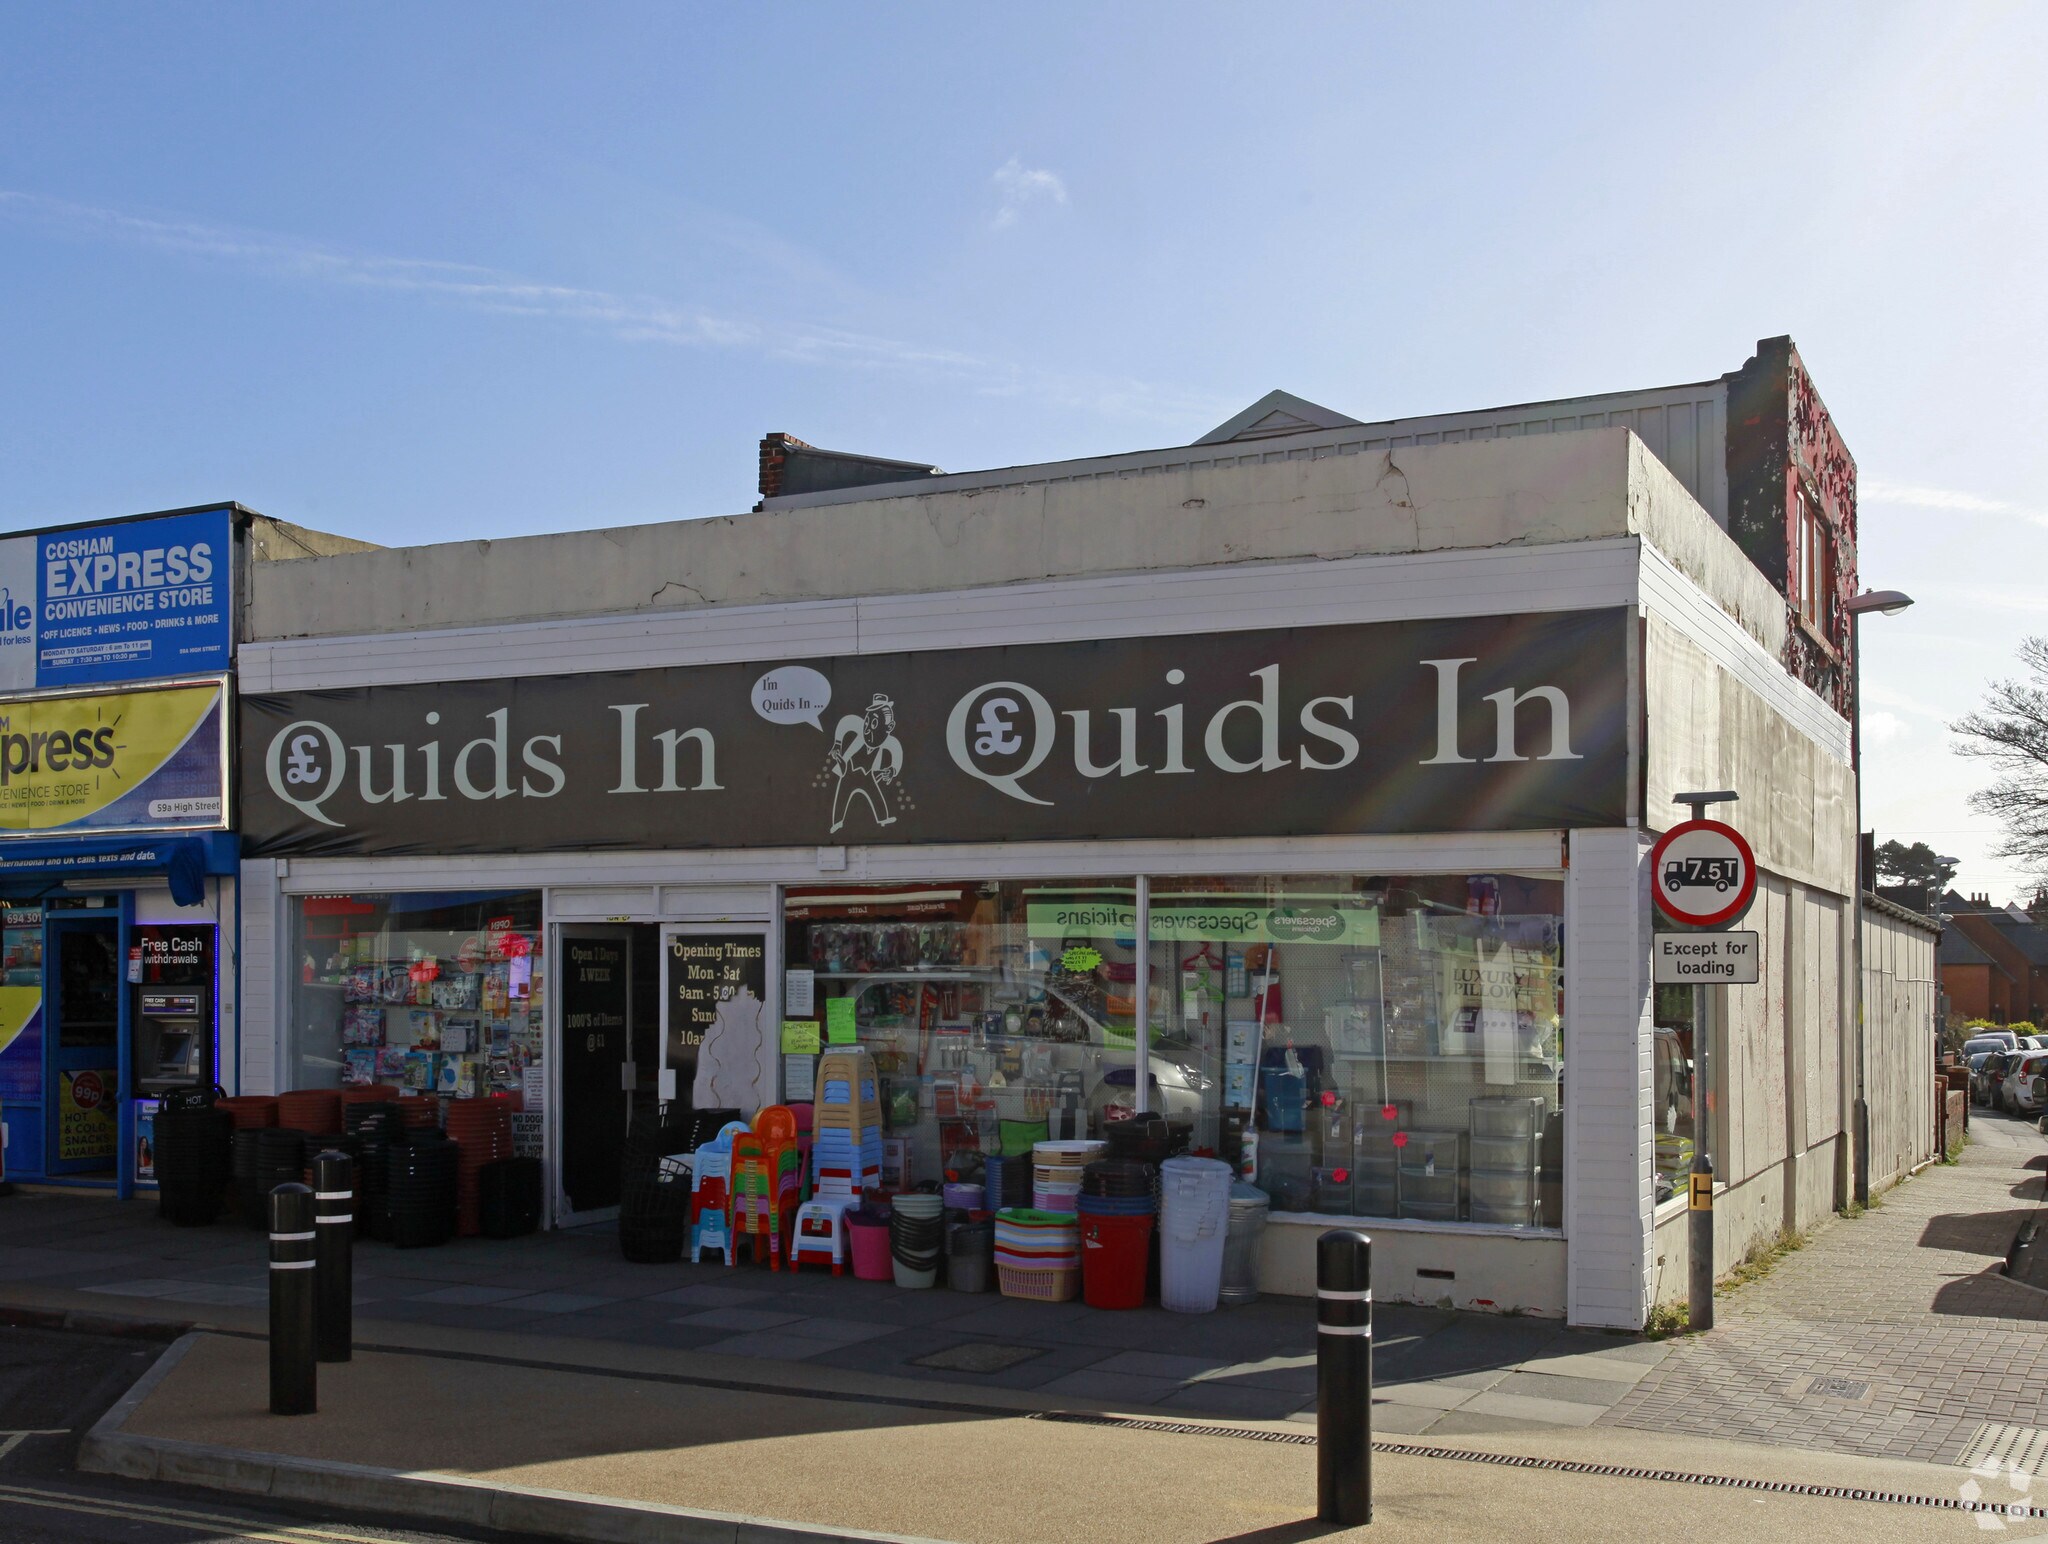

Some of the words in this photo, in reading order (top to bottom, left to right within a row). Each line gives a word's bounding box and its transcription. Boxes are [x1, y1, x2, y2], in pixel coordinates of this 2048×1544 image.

[46, 536, 113, 560] COSHAM
[47, 543, 213, 598] EXPRESS
[45, 592, 154, 620] CONVENIENCE
[159, 587, 213, 609] STORE
[44, 630, 58, 640] OFF
[60, 626, 92, 638] LICENCE
[98, 624, 120, 634] NEWS
[126, 621, 148, 632] FOOD
[155, 618, 184, 628] DRINKS
[194, 614, 219, 624] MORE
[4, 636, 14, 645] for
[16, 635, 31, 644] less
[43, 648, 66, 656] MONDAY
[762, 677, 778, 691] I'm
[762, 698, 795, 714] Quids
[799, 698, 810, 710] In
[1418, 657, 1584, 764] In
[1, 726, 114, 786] press
[608, 703, 725, 794] In
[54, 784, 90, 797] STORE
[157, 804, 172, 812] 59a
[174, 802, 193, 813] High
[195, 802, 220, 811] Street
[120, 852, 136, 861] and
[137, 850, 156, 860] data
[141, 937, 168, 952] Free
[172, 936, 202, 952] Cash
[674, 942, 723, 962] Opening
[725, 943, 761, 958] Times
[1663, 941, 1718, 958] Except
[1725, 940, 1748, 954] for
[144, 953, 198, 964] withdrawals
[571, 946, 593, 964] Open
[586, 968, 611, 982] WEEK
[688, 965, 714, 980] Mon
[724, 966, 740, 980] Sat
[1676, 960, 1735, 976] loading
[1454, 969, 1525, 985] LUXURY
[680, 984, 704, 1000] 9am
[1454, 984, 1522, 999] PILLOW
[586, 1034, 596, 1052] @
[75, 1086, 100, 1102] 99p
[186, 1096, 202, 1104] HOT
[64, 1112, 88, 1122] HOT
[512, 1114, 522, 1123] NO
[76, 1122, 106, 1133] COLD
[516, 1124, 540, 1132] EXCEPT
[64, 1133, 112, 1146] SNACKS
[1692, 1176, 1712, 1206] H
